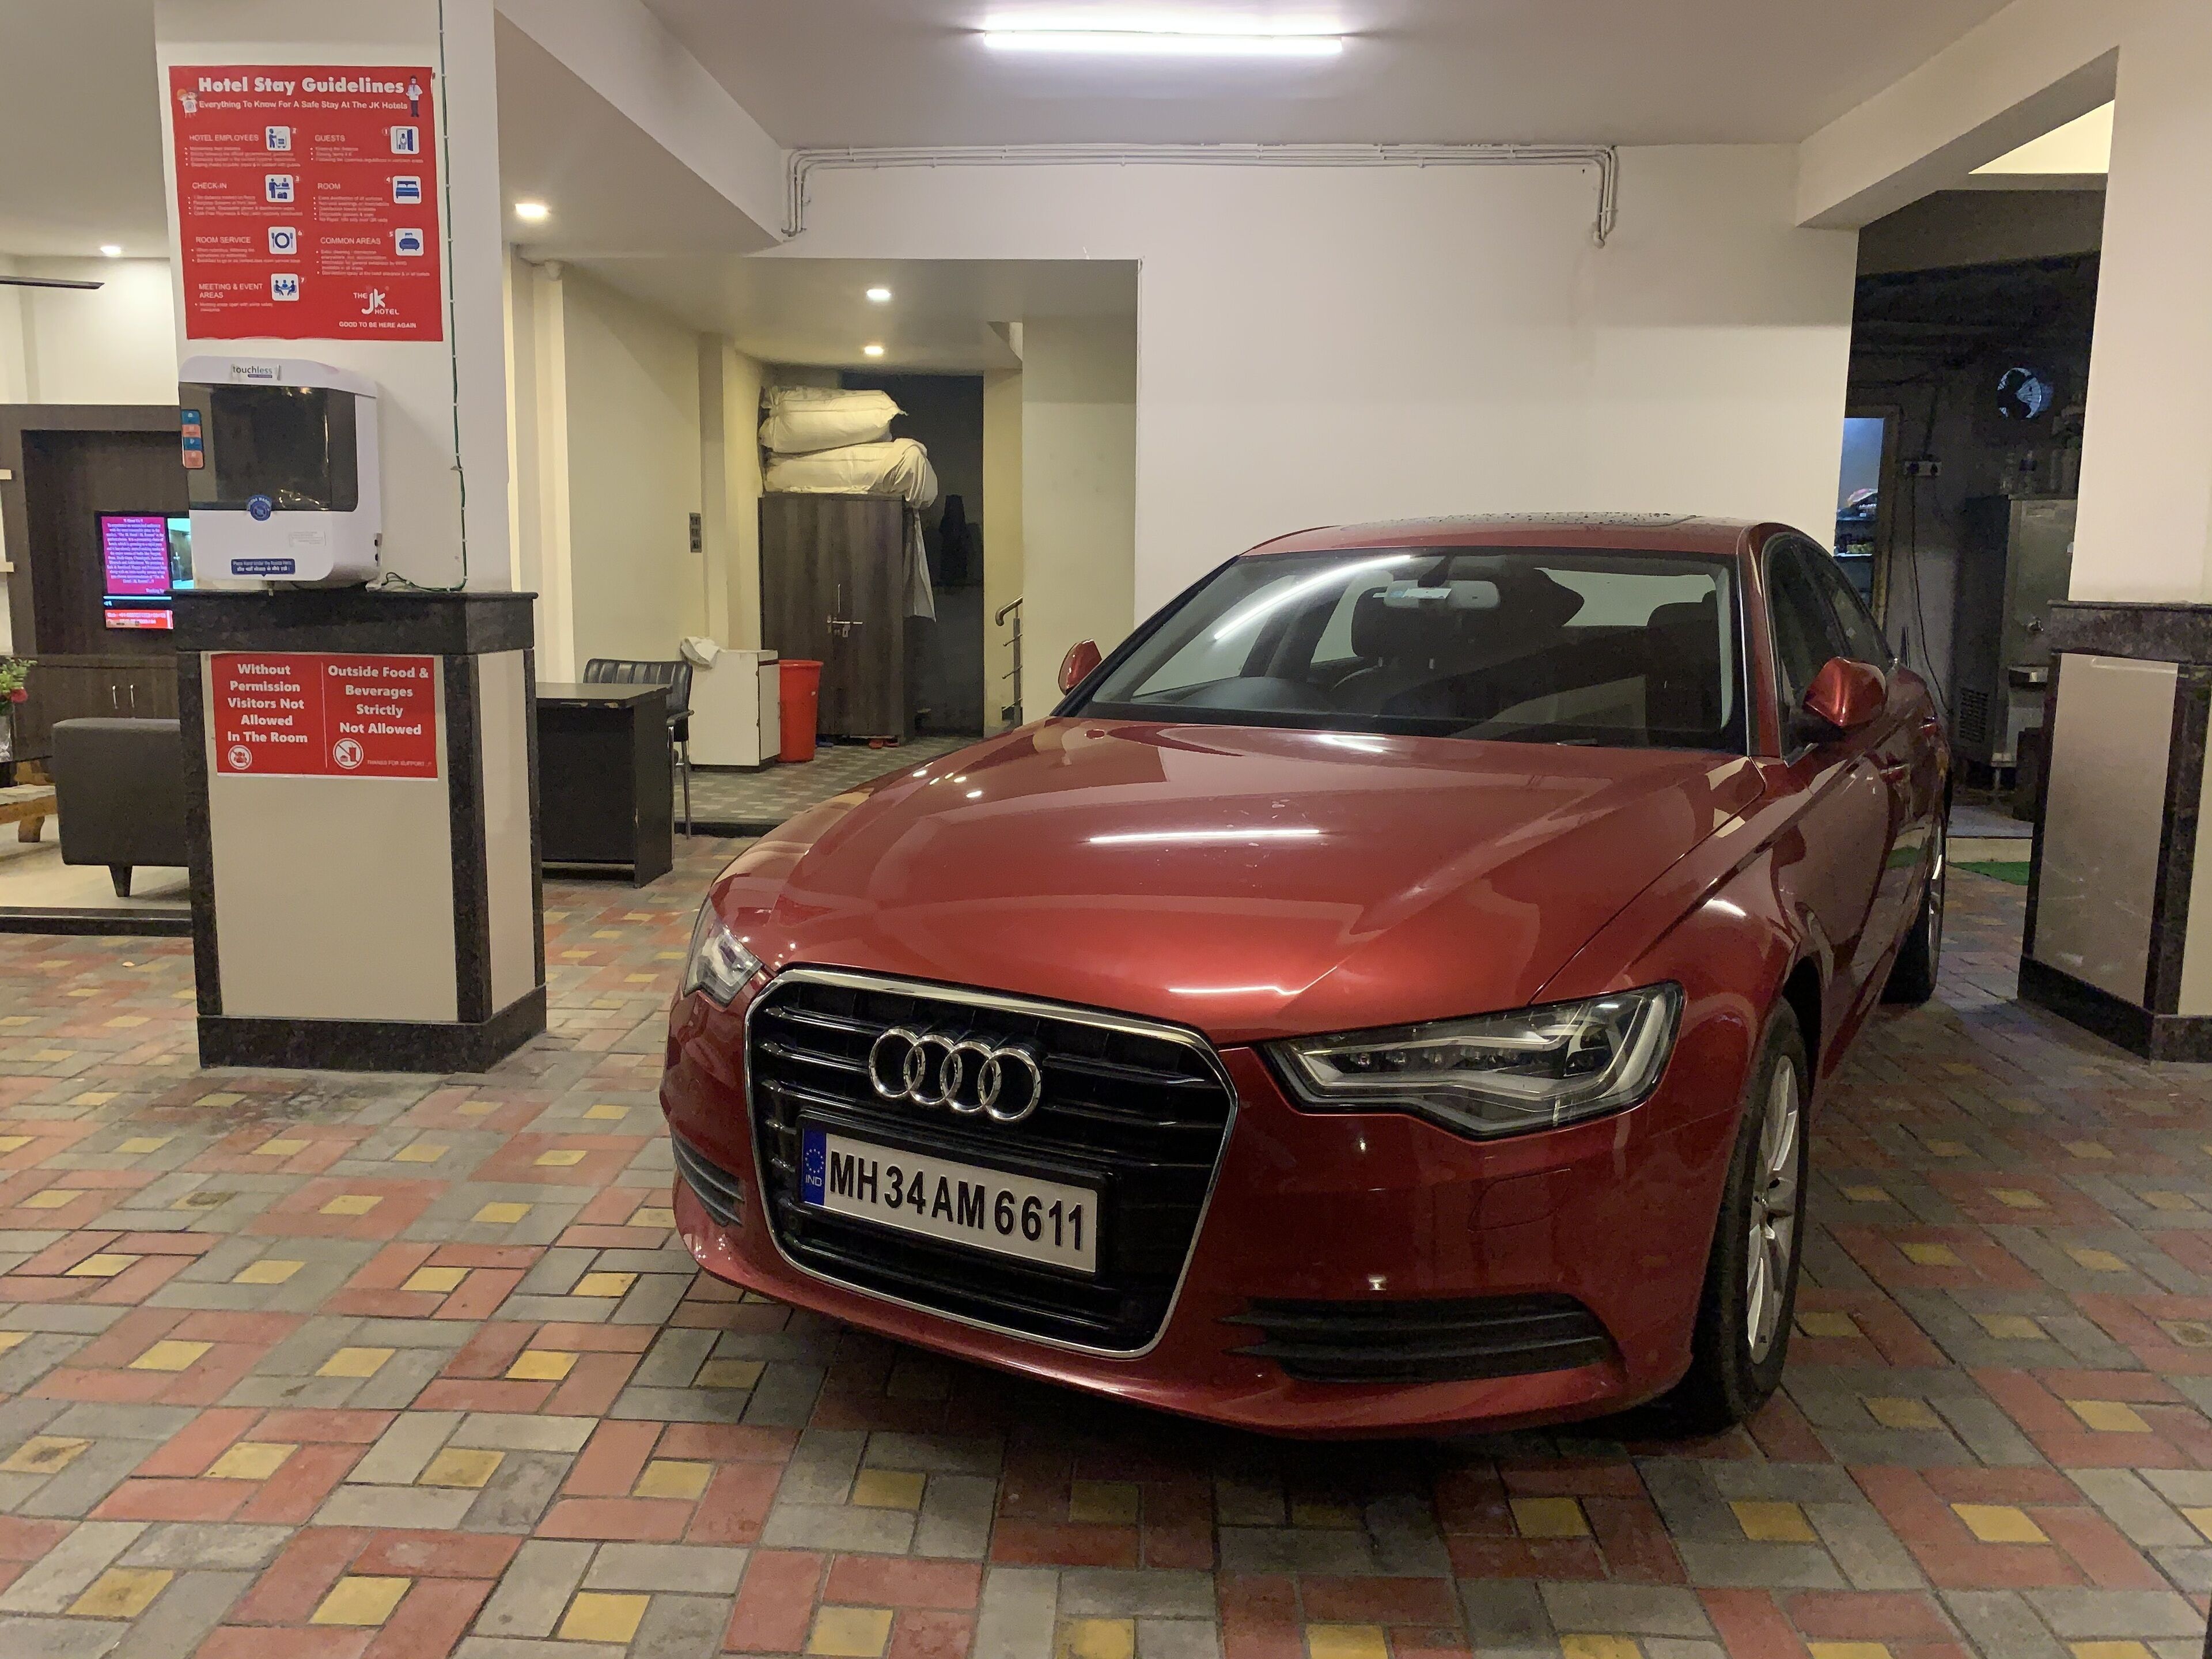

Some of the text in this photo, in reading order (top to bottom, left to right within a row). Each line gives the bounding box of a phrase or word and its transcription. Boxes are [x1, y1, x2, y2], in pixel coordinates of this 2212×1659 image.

[198, 76, 404, 96] Hotel Stay Guidelines
[199, 100, 241, 109] Everything
[301, 100, 319, 108] Safe
[321, 100, 339, 109] Stay
[382, 101, 408, 109] Hotels
[315, 134, 346, 142] GUESTS
[233, 365, 272, 374] touchless
[237, 663, 291, 676] Without
[328, 665, 429, 679] Outside Food &
[230, 681, 300, 692] Permission
[346, 684, 414, 699] Beverages
[228, 697, 305, 710] Visitors Not
[357, 704, 403, 719] Strictly
[241, 714, 293, 726] Allowed
[340, 722, 422, 735] Not Allowed
[228, 731, 308, 743] In The Room
[805, 1174, 823, 1187] IND
